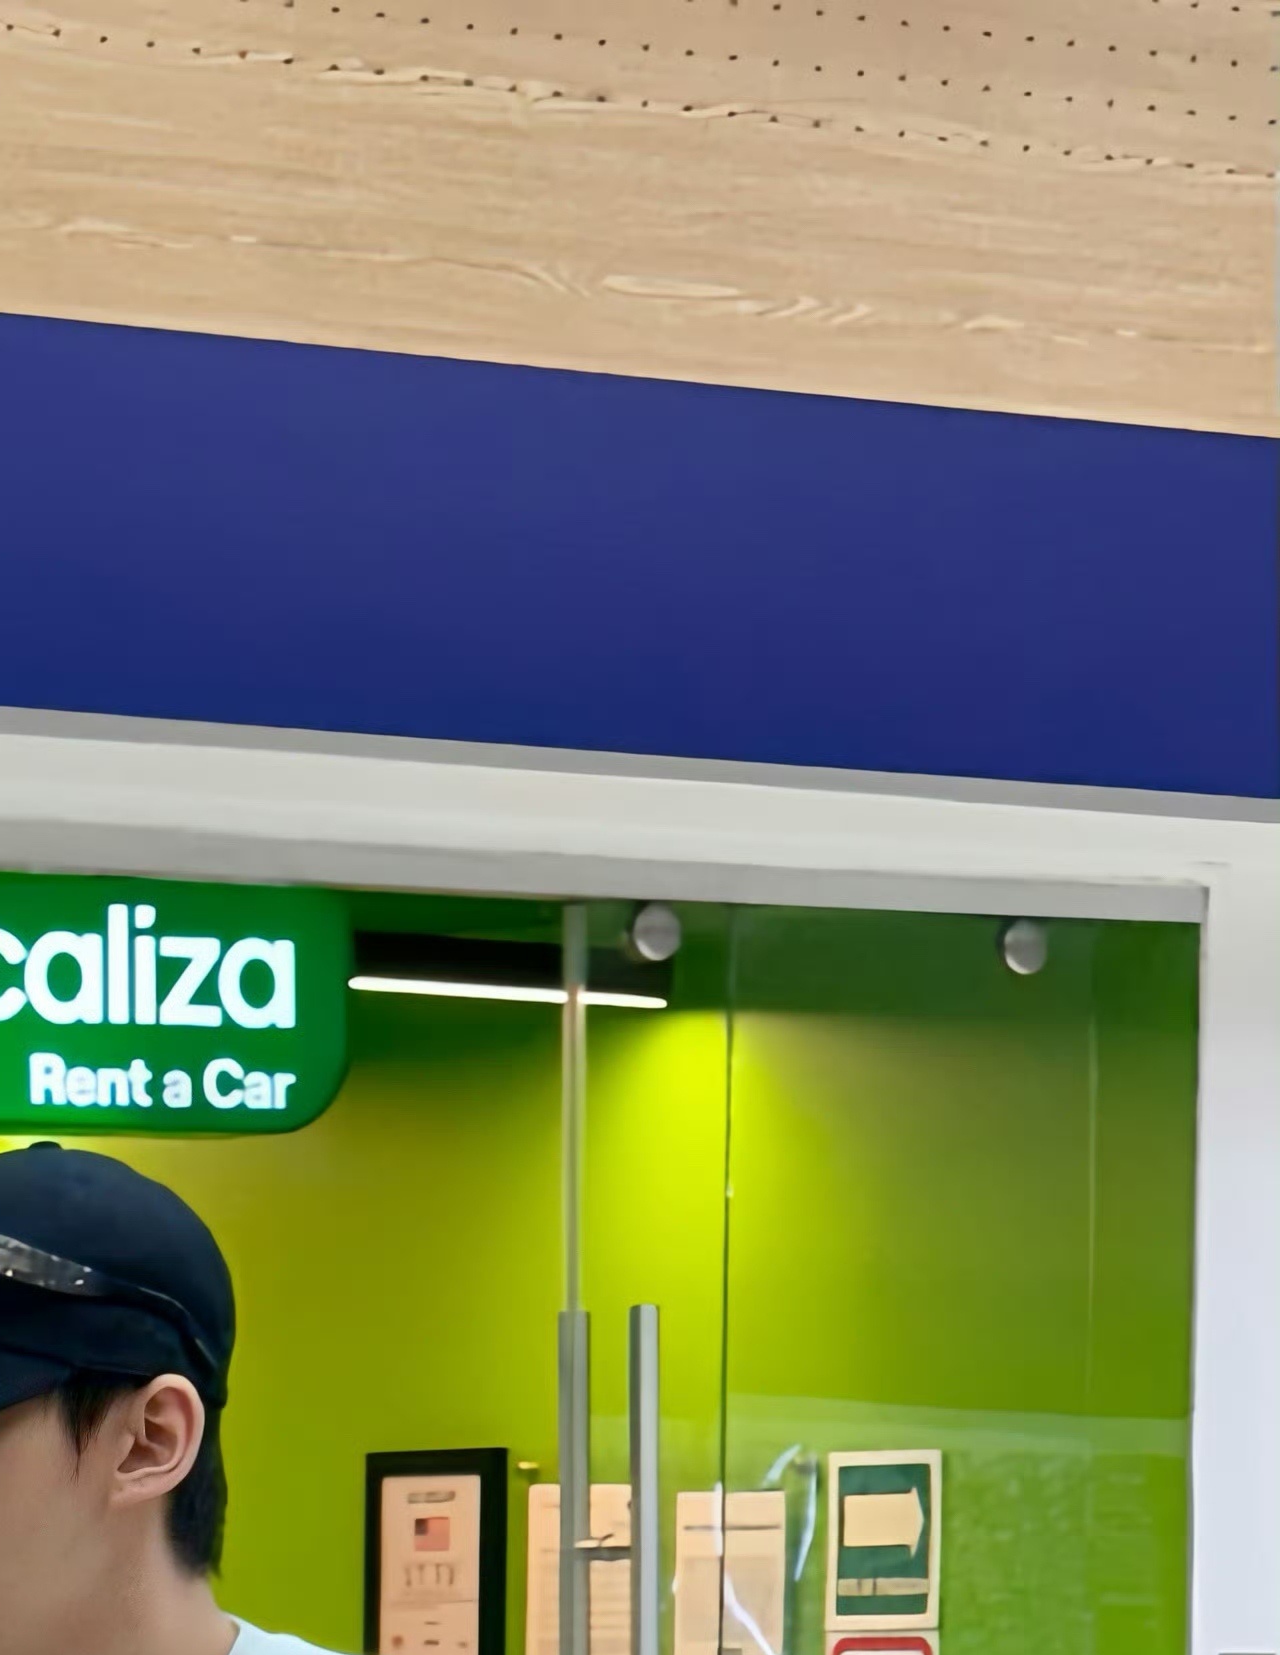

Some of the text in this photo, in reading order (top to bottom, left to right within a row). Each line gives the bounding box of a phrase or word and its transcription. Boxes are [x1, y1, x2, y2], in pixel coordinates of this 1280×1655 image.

[28, 1052, 297, 1110] Rent a Car
